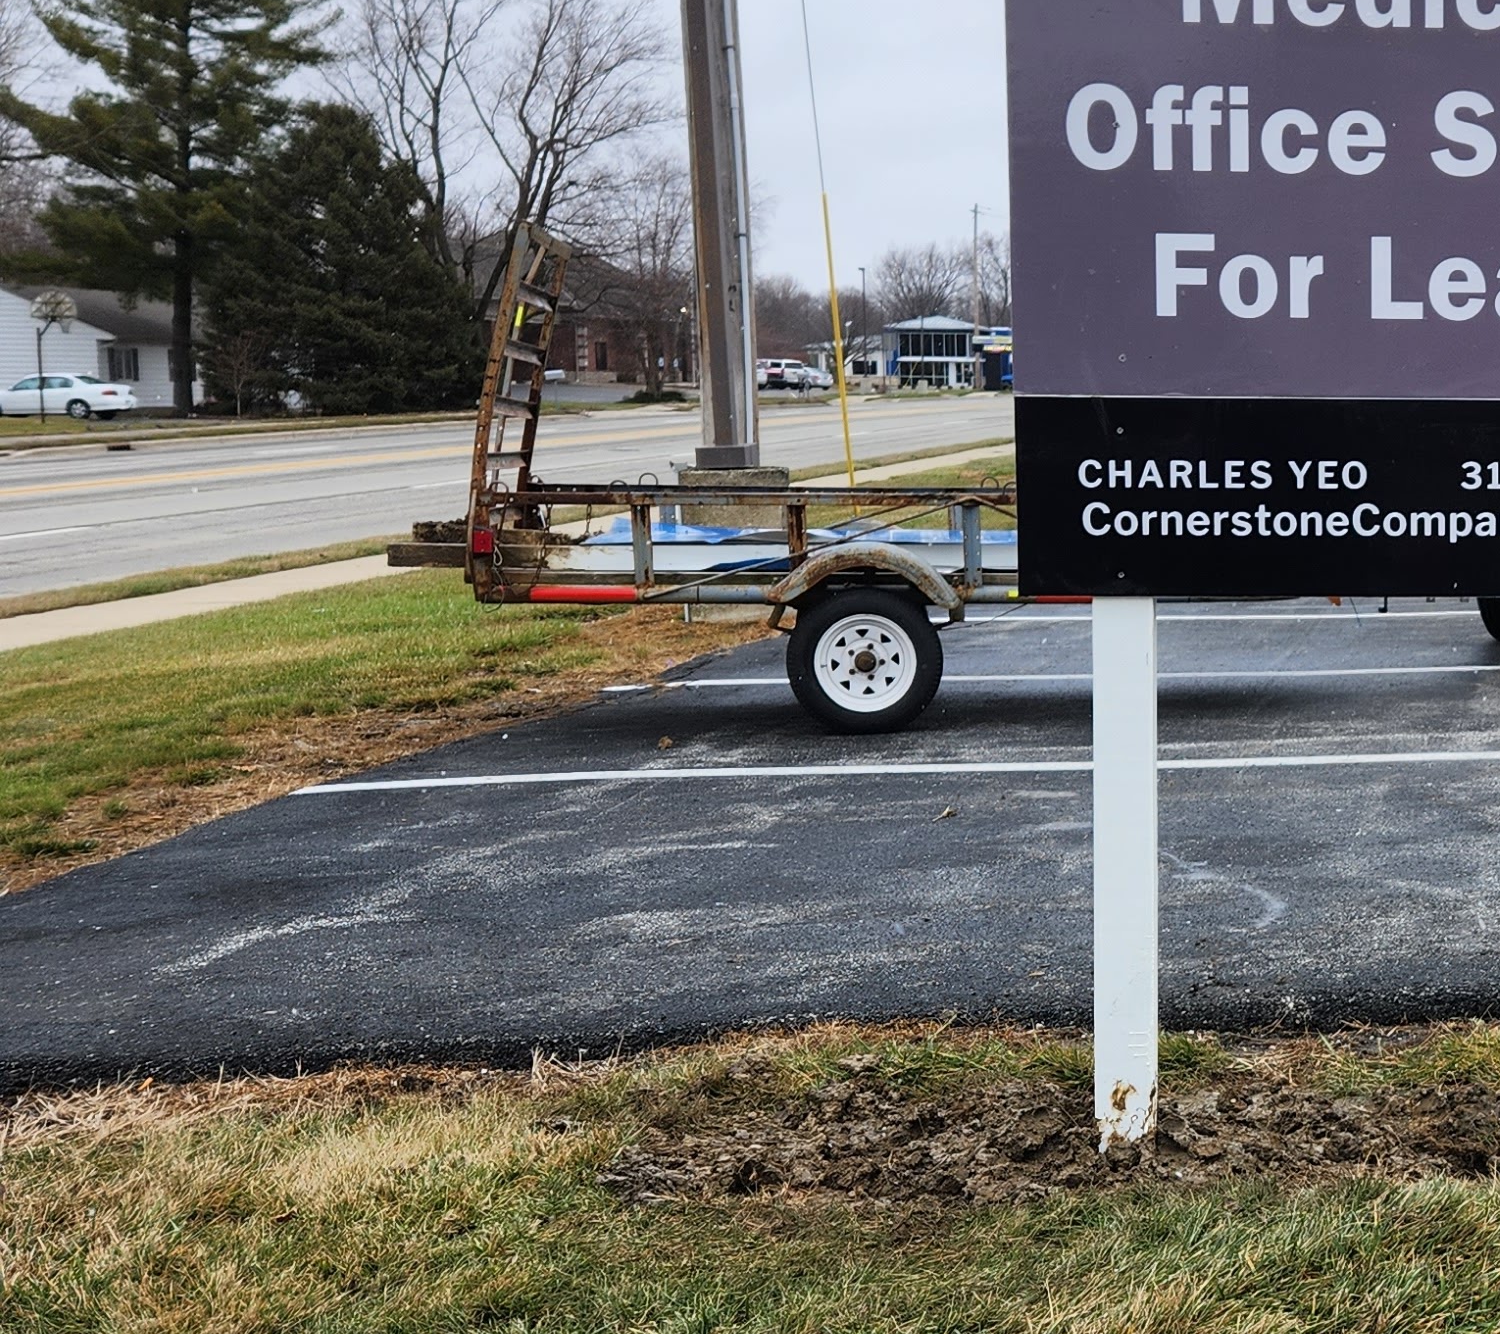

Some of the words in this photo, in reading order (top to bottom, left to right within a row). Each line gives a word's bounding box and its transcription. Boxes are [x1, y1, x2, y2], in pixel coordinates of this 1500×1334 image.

[1065, 83, 1387, 176] Office
[1155, 232, 1324, 319] For
[1078, 459, 1273, 490] CHARLES
[1287, 460, 1368, 490] YEO
